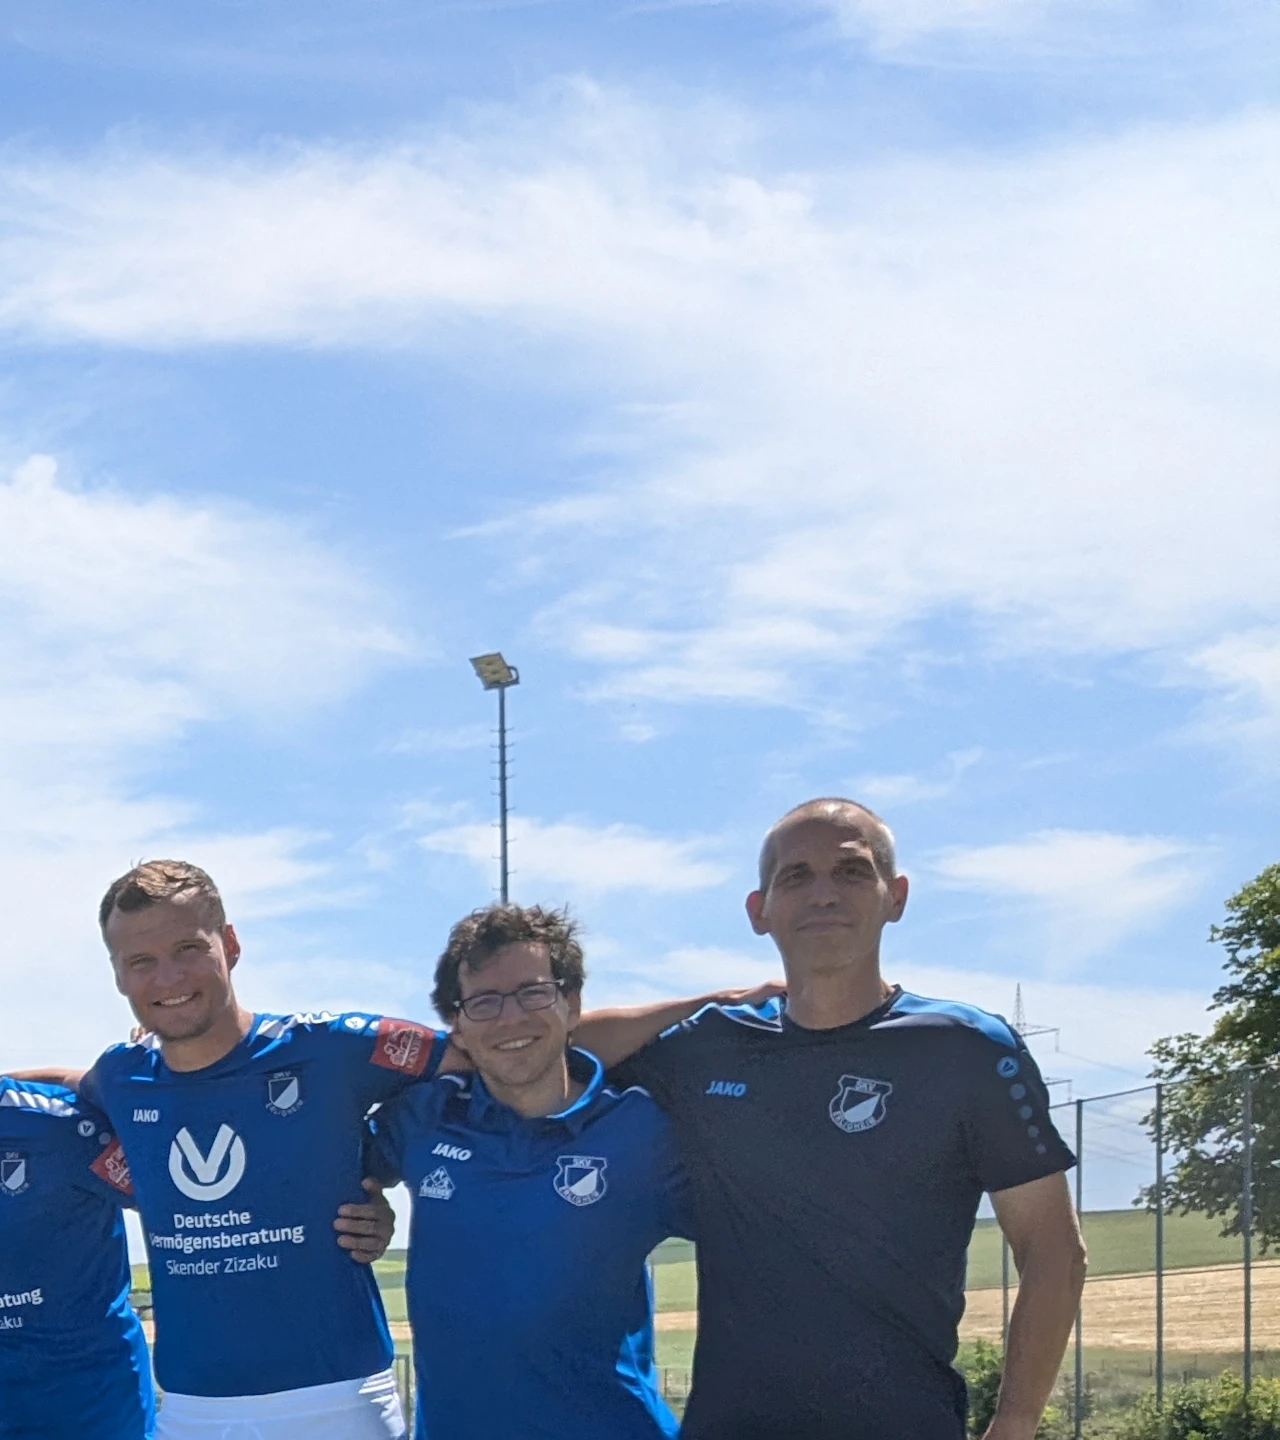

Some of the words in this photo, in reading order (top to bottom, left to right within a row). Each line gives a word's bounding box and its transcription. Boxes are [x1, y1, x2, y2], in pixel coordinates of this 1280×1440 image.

[705, 1080, 746, 1097] JAKO
[432, 1143, 472, 1161] JAKO
[174, 1209, 252, 1229] Deutsche
[166, 1258, 221, 1276] Skender
[224, 1253, 279, 1273] Zizaku
